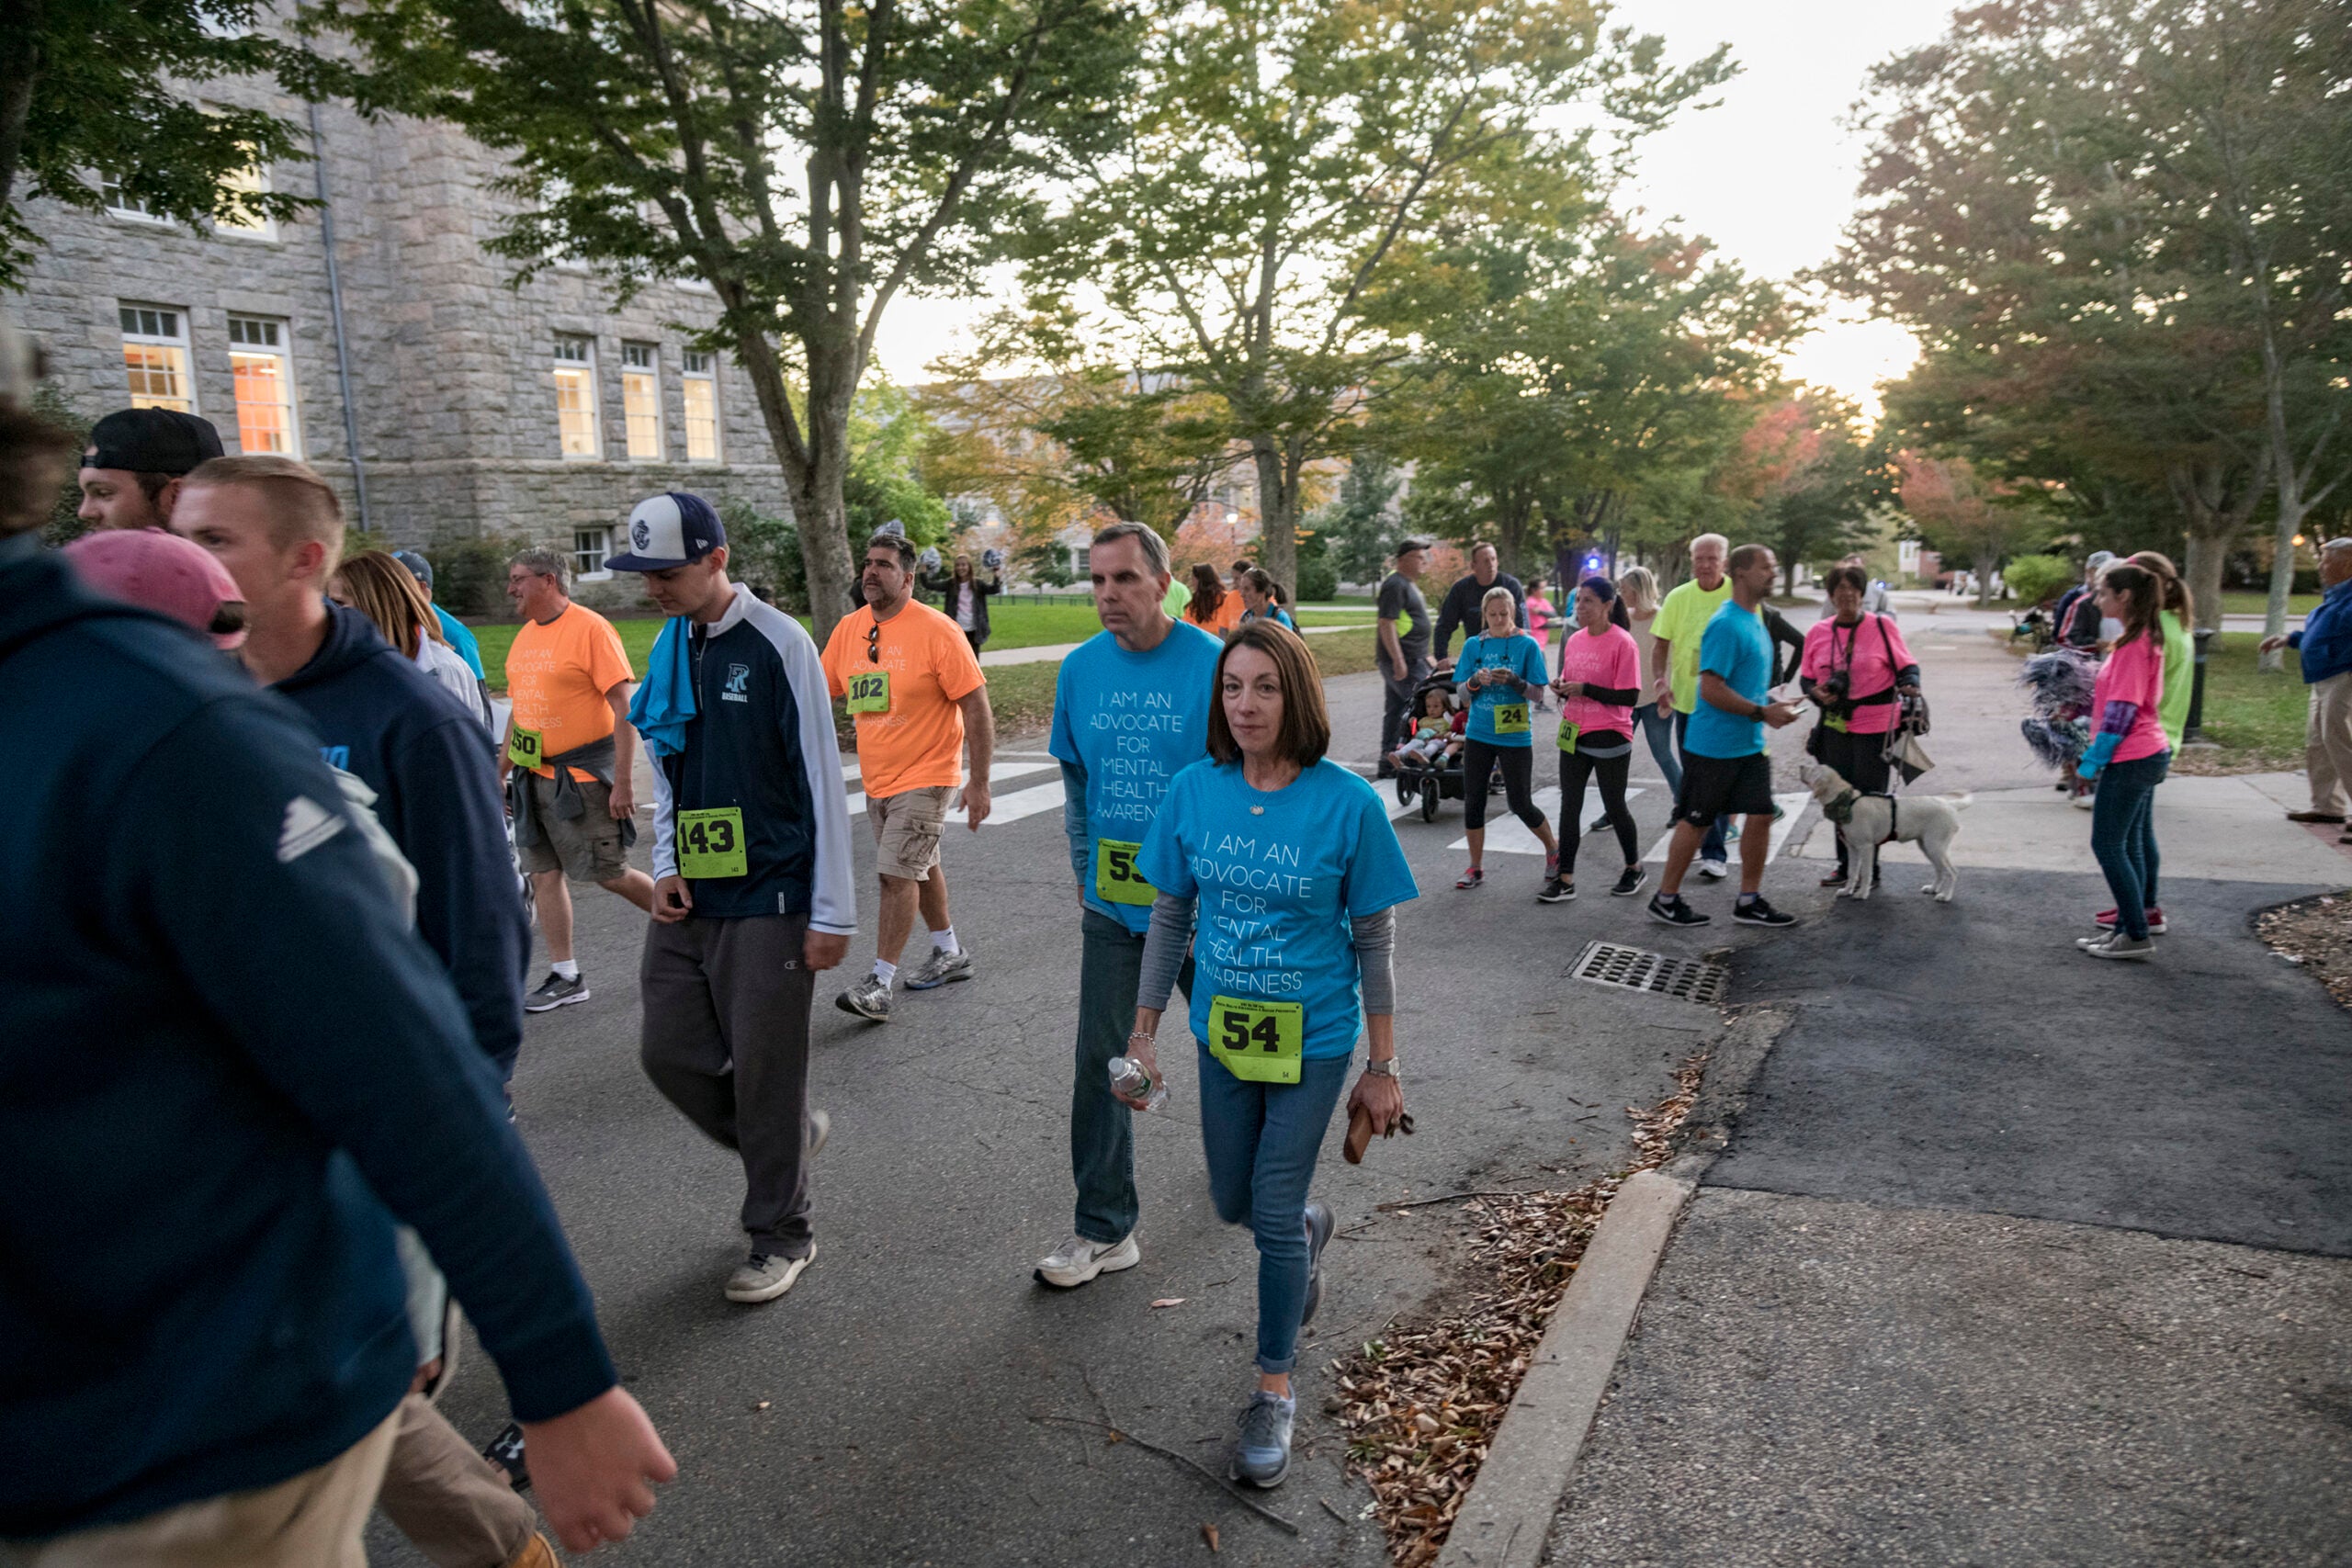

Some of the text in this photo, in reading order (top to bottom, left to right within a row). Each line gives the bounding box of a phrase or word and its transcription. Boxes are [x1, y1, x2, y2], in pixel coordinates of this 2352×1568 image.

[887, 646, 903, 656] AN
[852, 677, 883, 701] 102
[1099, 692, 1172, 709] I AM AN
[1089, 713, 1183, 733] ADVOCATE
[1501, 707, 1522, 724] 24
[1116, 736, 1150, 753] FOR
[1101, 757, 1170, 777] MENTAL
[1102, 780, 1170, 799] HEALTH
[1095, 801, 1158, 822] AWAREN
[680, 819, 735, 855] 143
[1203, 830, 1300, 868] I AM AN
[1192, 855, 1313, 898] ADVOCATE
[1222, 889, 1267, 915] FOR
[1212, 915, 1287, 942] ENTAL
[1200, 950, 1303, 994] AWARENESS
[1222, 1010, 1280, 1054] 54
